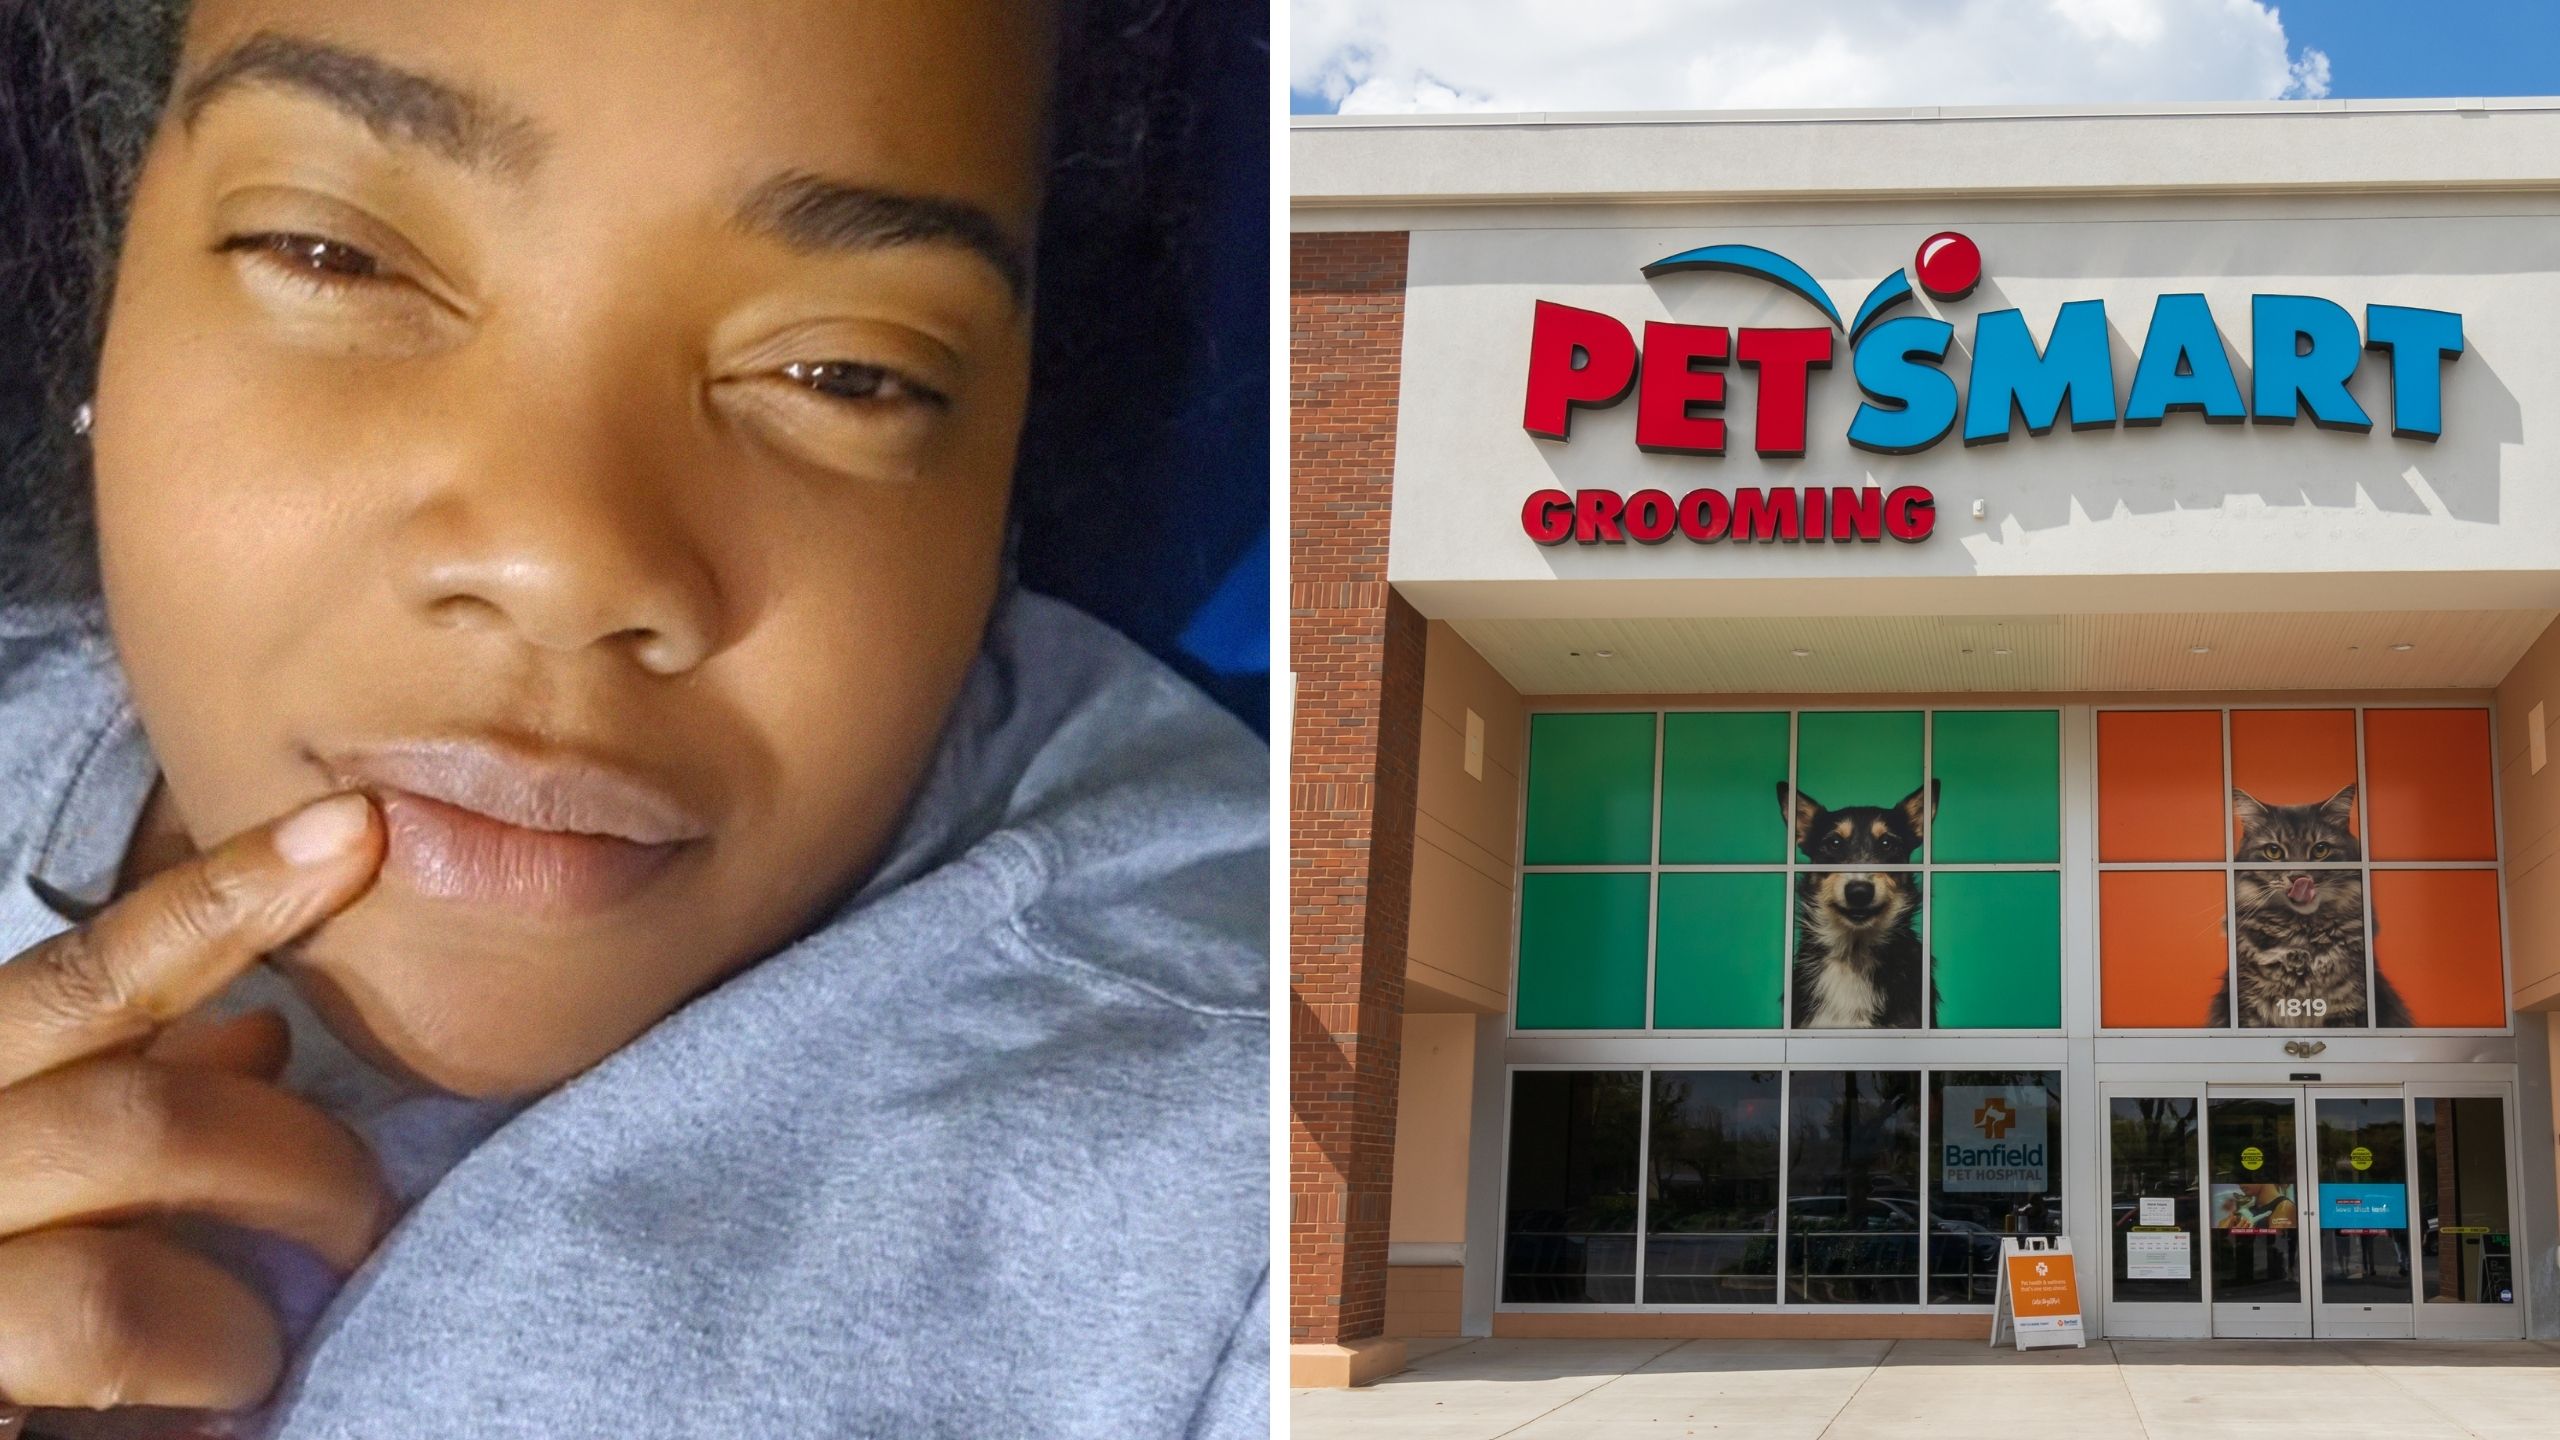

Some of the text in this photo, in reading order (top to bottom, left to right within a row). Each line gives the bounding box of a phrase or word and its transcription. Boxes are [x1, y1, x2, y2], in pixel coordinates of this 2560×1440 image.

[1521, 485, 1936, 546] GROOMING
[2276, 998, 2327, 1017] 1819
[1945, 1143, 2043, 1167] Banfield
[1947, 1168, 2042, 1181] PET HOSPITAL
